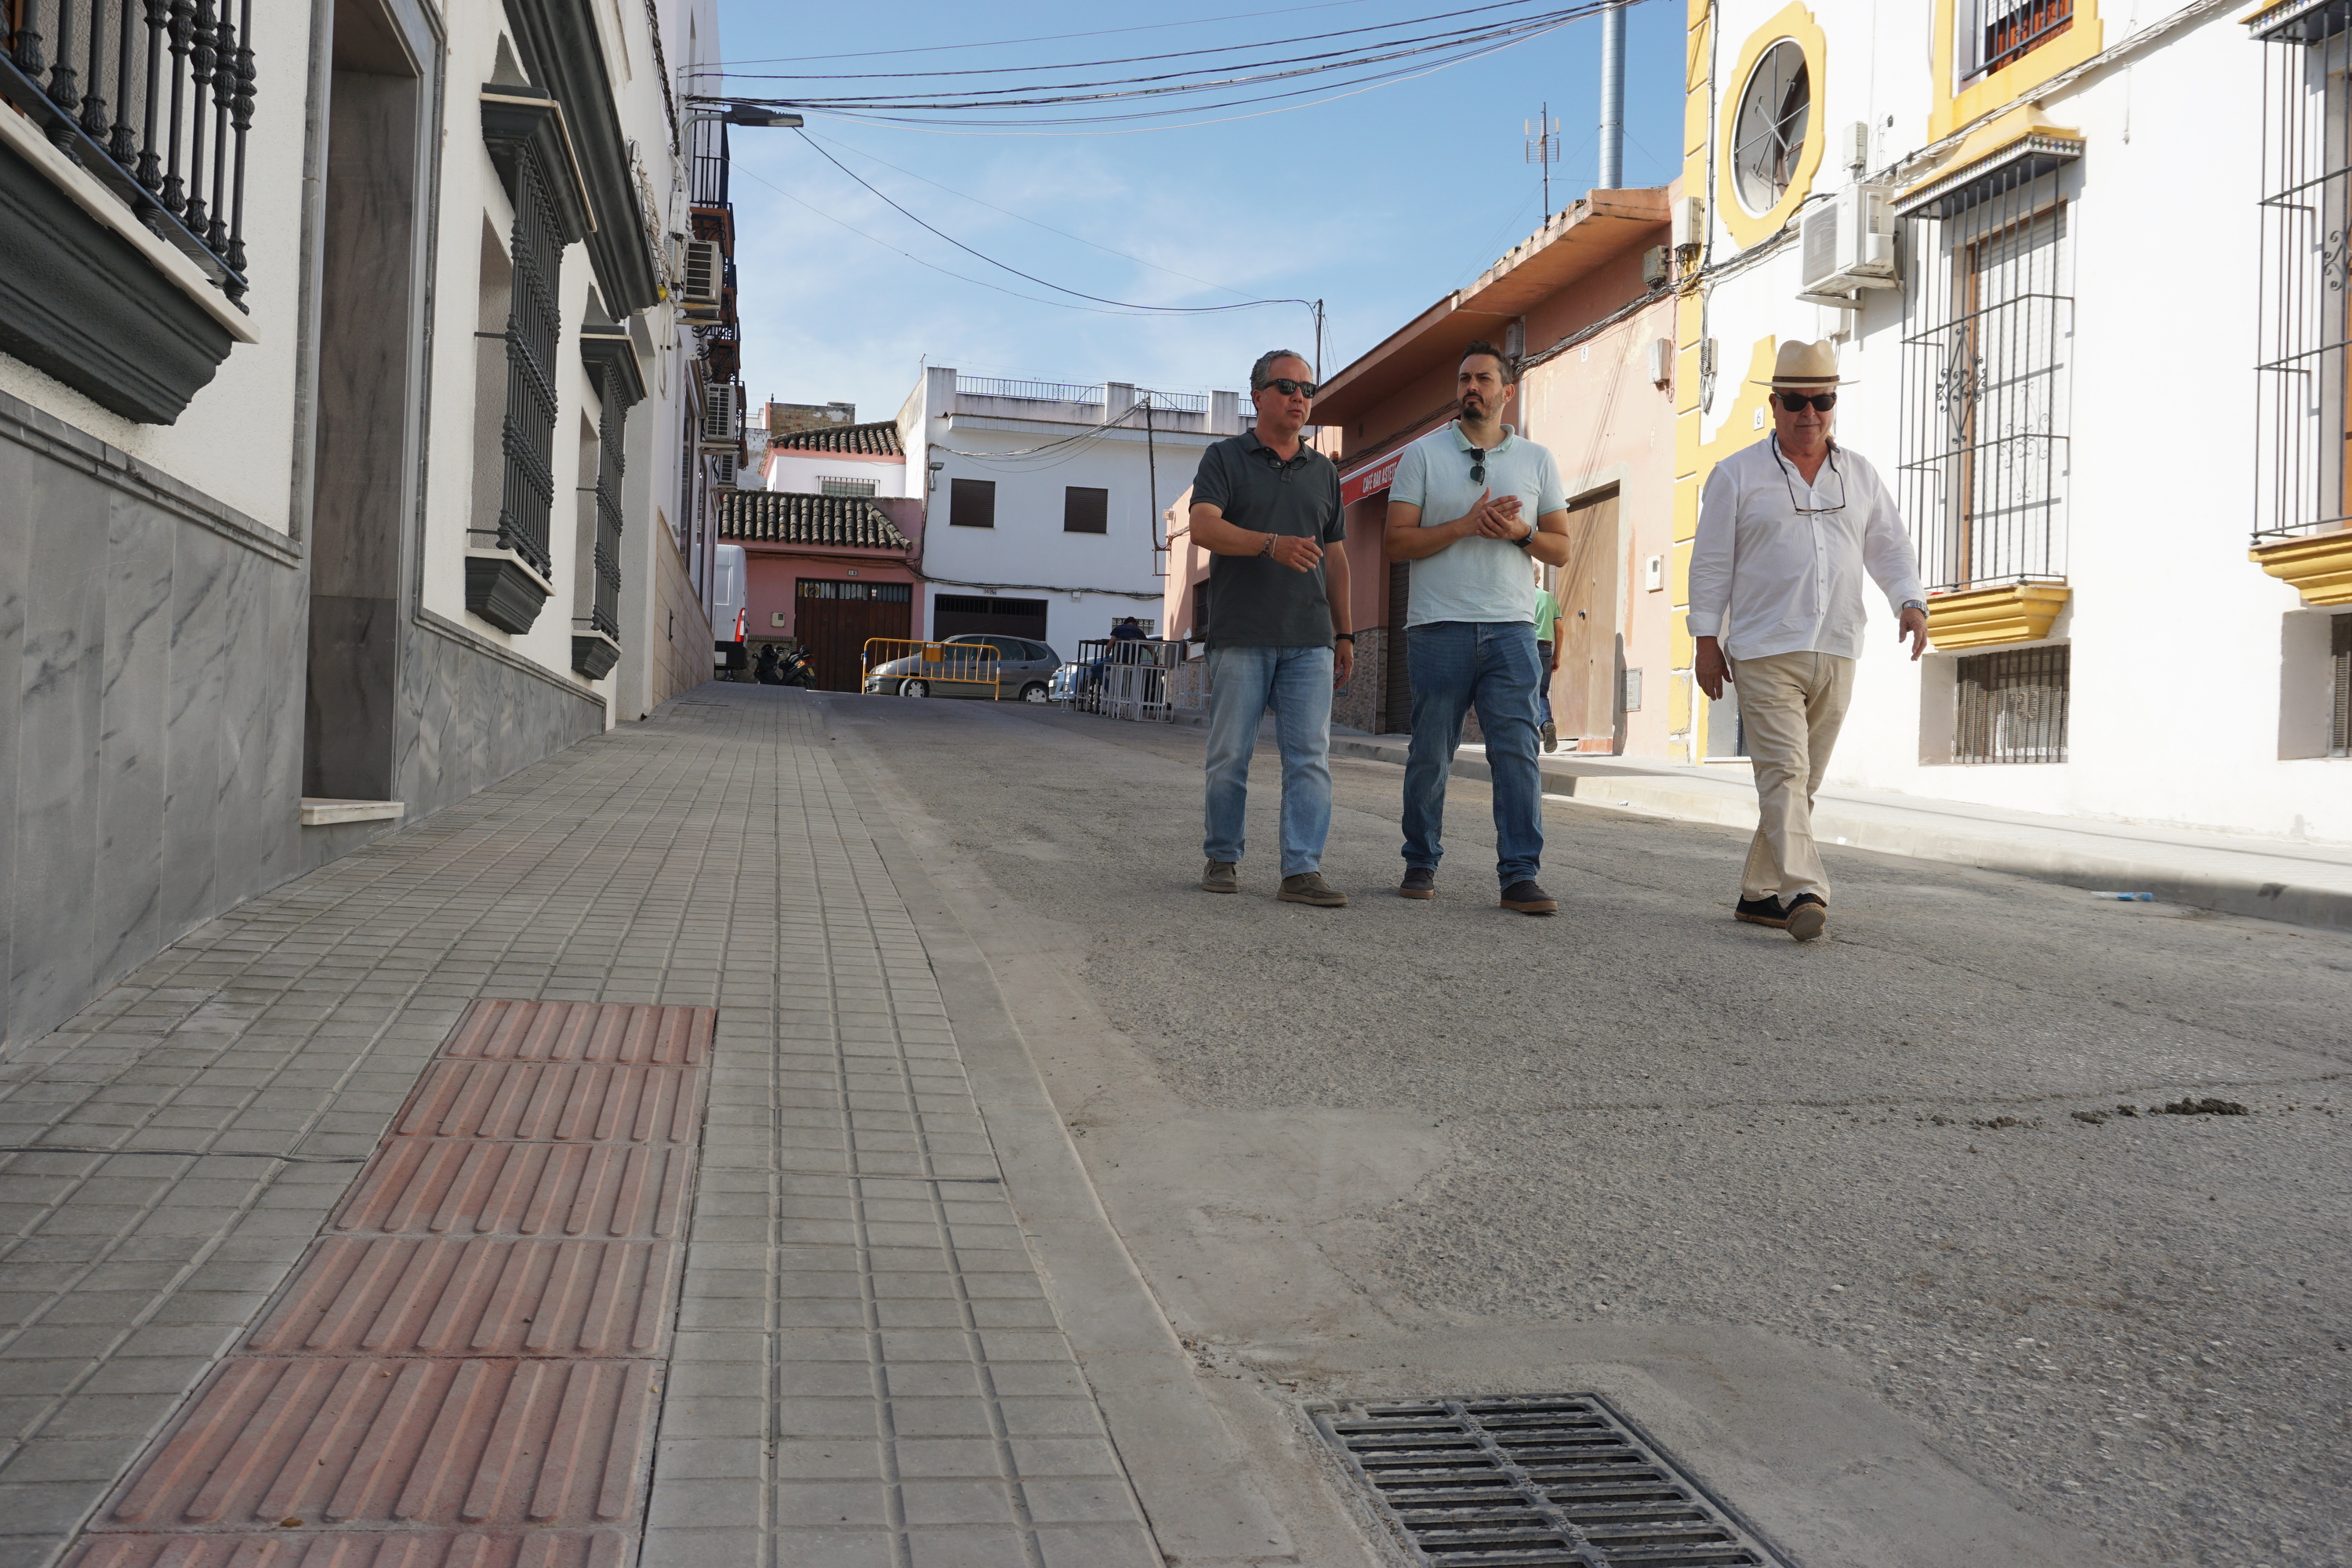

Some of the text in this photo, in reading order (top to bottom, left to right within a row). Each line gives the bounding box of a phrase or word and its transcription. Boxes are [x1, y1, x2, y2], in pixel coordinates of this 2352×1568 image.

[1582, 347, 1587, 359] 8
[1756, 411, 1762, 425] 6
[1363, 471, 1374, 493] CAFÉ
[1373, 470, 1382, 488] BAR
